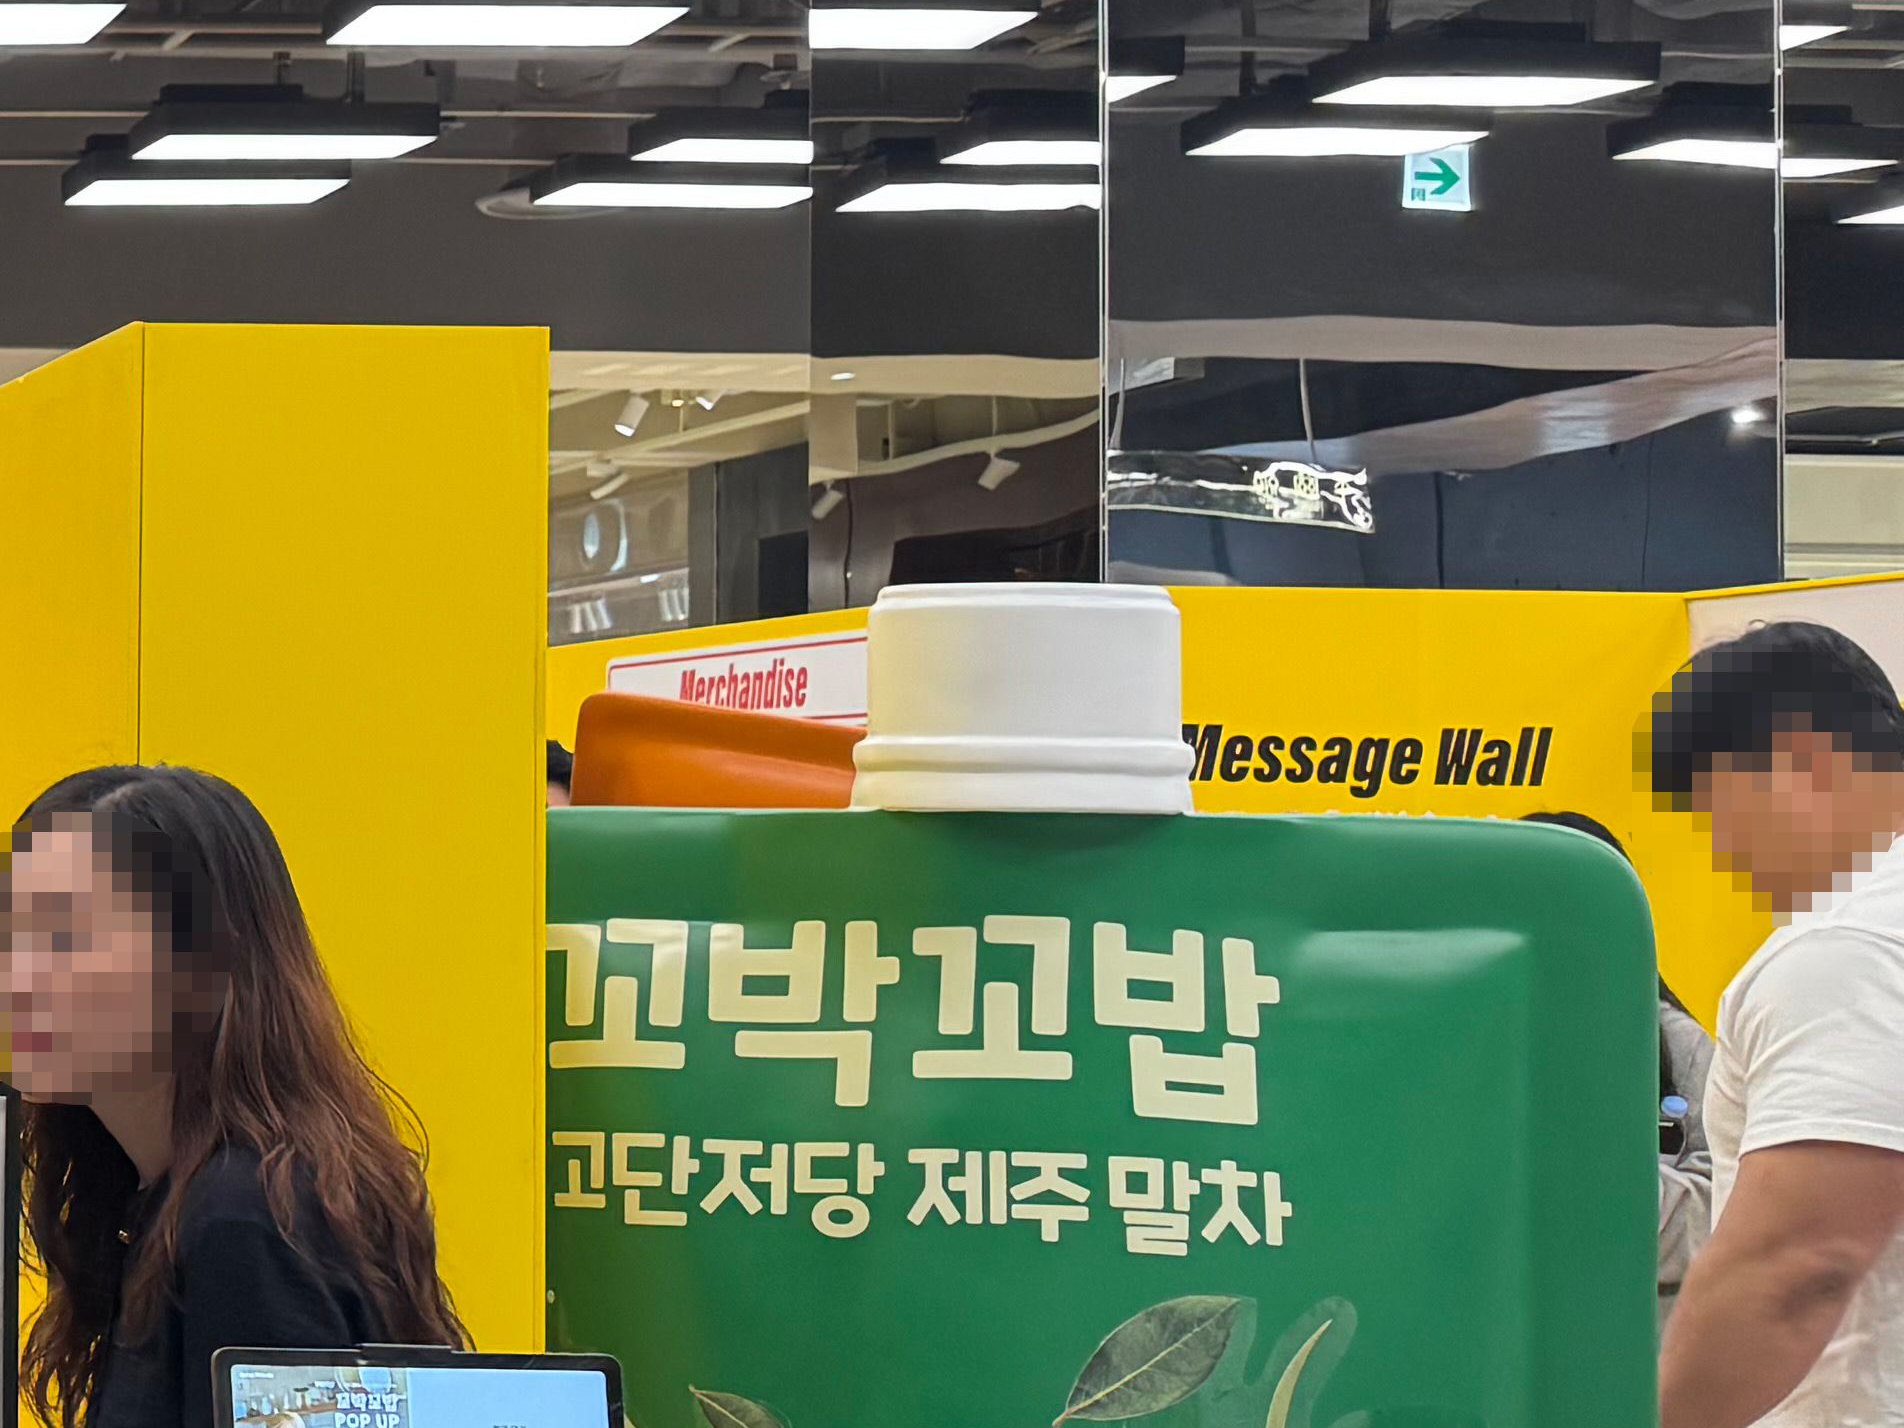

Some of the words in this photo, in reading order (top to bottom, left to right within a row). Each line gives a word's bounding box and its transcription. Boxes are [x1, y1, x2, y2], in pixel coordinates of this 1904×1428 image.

[680, 657, 808, 710] Merchandise
[1182, 724, 1423, 799] Message
[1434, 727, 1553, 787] Wall
[545, 914, 1280, 1126] 꼬박꼬밥
[552, 1131, 885, 1238] 고단저당
[907, 1148, 1090, 1242] 제주
[1108, 1158, 1292, 1256] 말차
[335, 1413, 371, 1428] POP
[376, 1414, 400, 1428] UP
